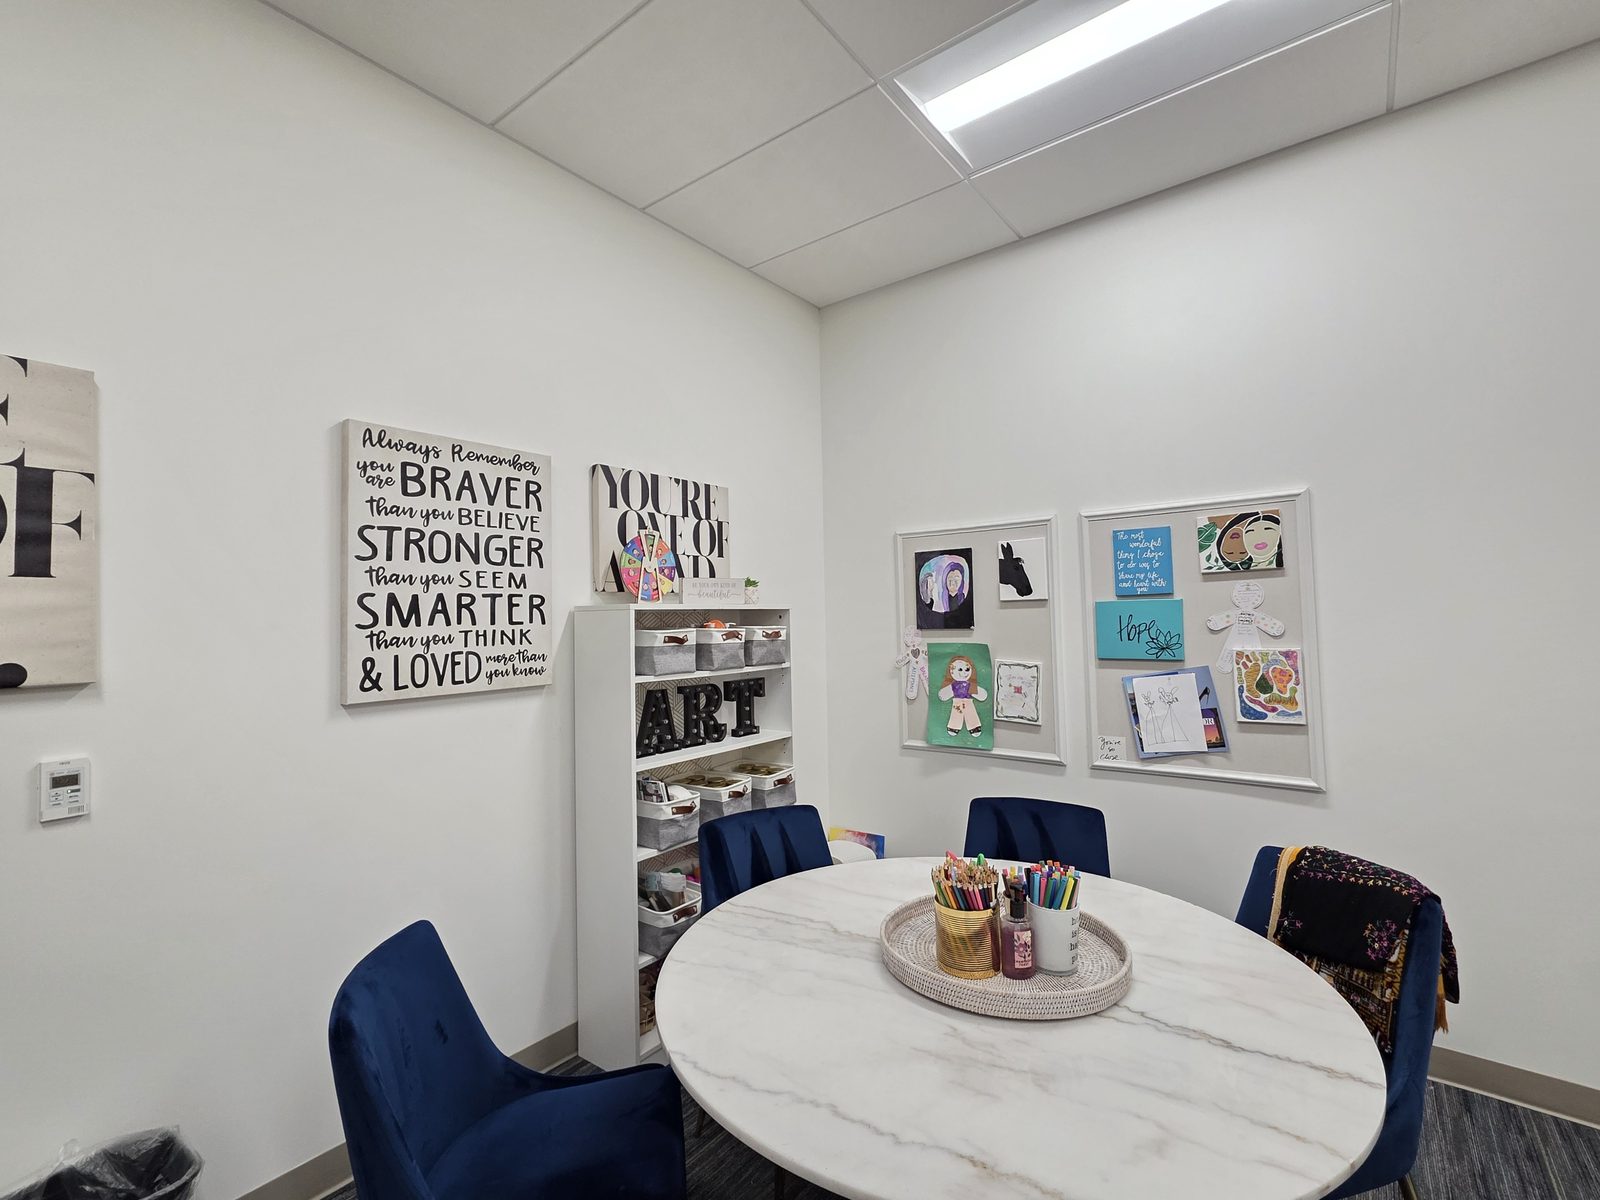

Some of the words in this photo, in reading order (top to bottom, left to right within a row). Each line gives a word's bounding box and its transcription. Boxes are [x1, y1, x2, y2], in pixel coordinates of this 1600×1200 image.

[356, 459, 395, 478] you
[362, 428, 442, 463] Always
[451, 443, 540, 475] Remember
[365, 475, 395, 489] are
[400, 461, 542, 512] BRAVER
[592, 464, 719, 522] YOU'RE
[365, 496, 417, 519] than
[420, 506, 454, 527] you
[457, 508, 540, 533] BELIEVE
[354, 524, 544, 568] STRONGER
[692, 519, 730, 559] OF
[365, 565, 417, 588] than
[420, 574, 454, 593] you
[458, 570, 527, 589] SEEM
[354, 592, 546, 630] SMARTER
[1117, 614, 1157, 643] Hope
[366, 630, 417, 651] than
[420, 635, 454, 654] you
[458, 629, 533, 648] THINK
[485, 652, 516, 666] more
[515, 649, 547, 663] than
[359, 656, 383, 692] &
[393, 651, 482, 691] LOVED
[486, 667, 511, 685] you
[512, 664, 546, 676] know
[636, 677, 766, 759] ART
